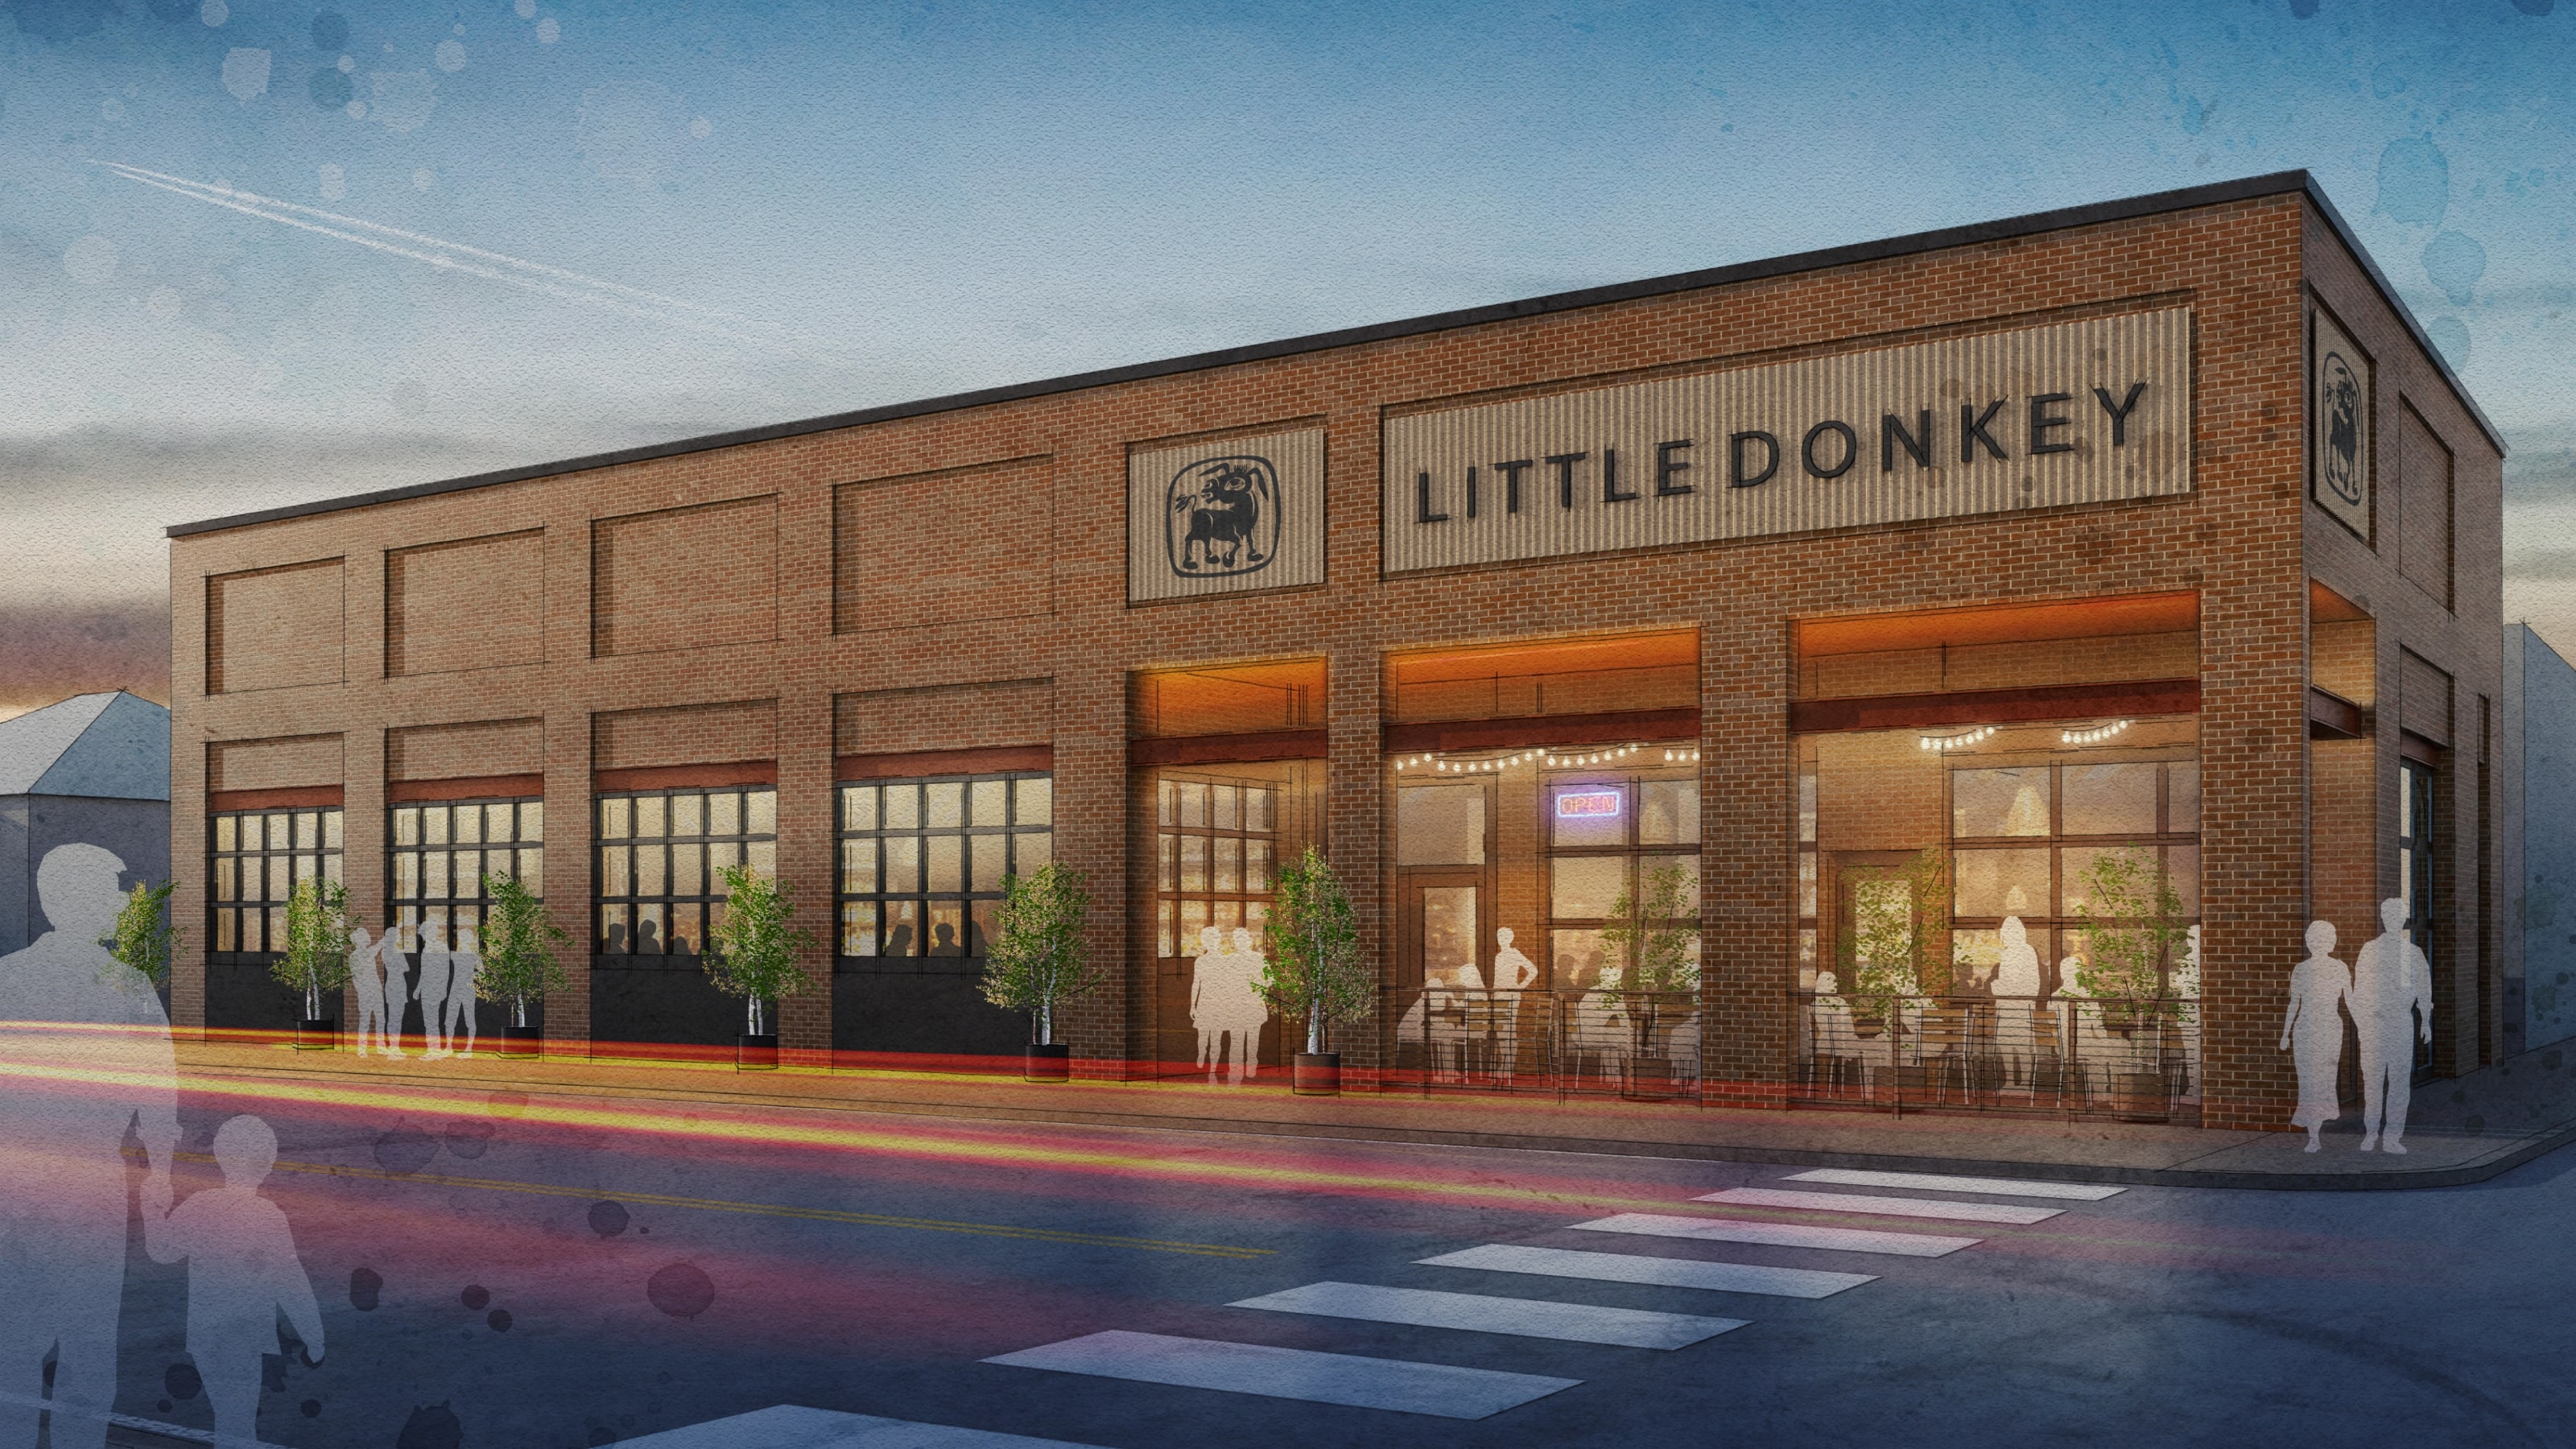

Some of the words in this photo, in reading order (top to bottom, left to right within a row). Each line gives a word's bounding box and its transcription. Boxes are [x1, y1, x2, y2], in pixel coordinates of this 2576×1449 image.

[1417, 439, 1695, 524] LITTLE
[1728, 380, 2147, 489] DONKEY
[1563, 796, 1614, 813] OPEN
